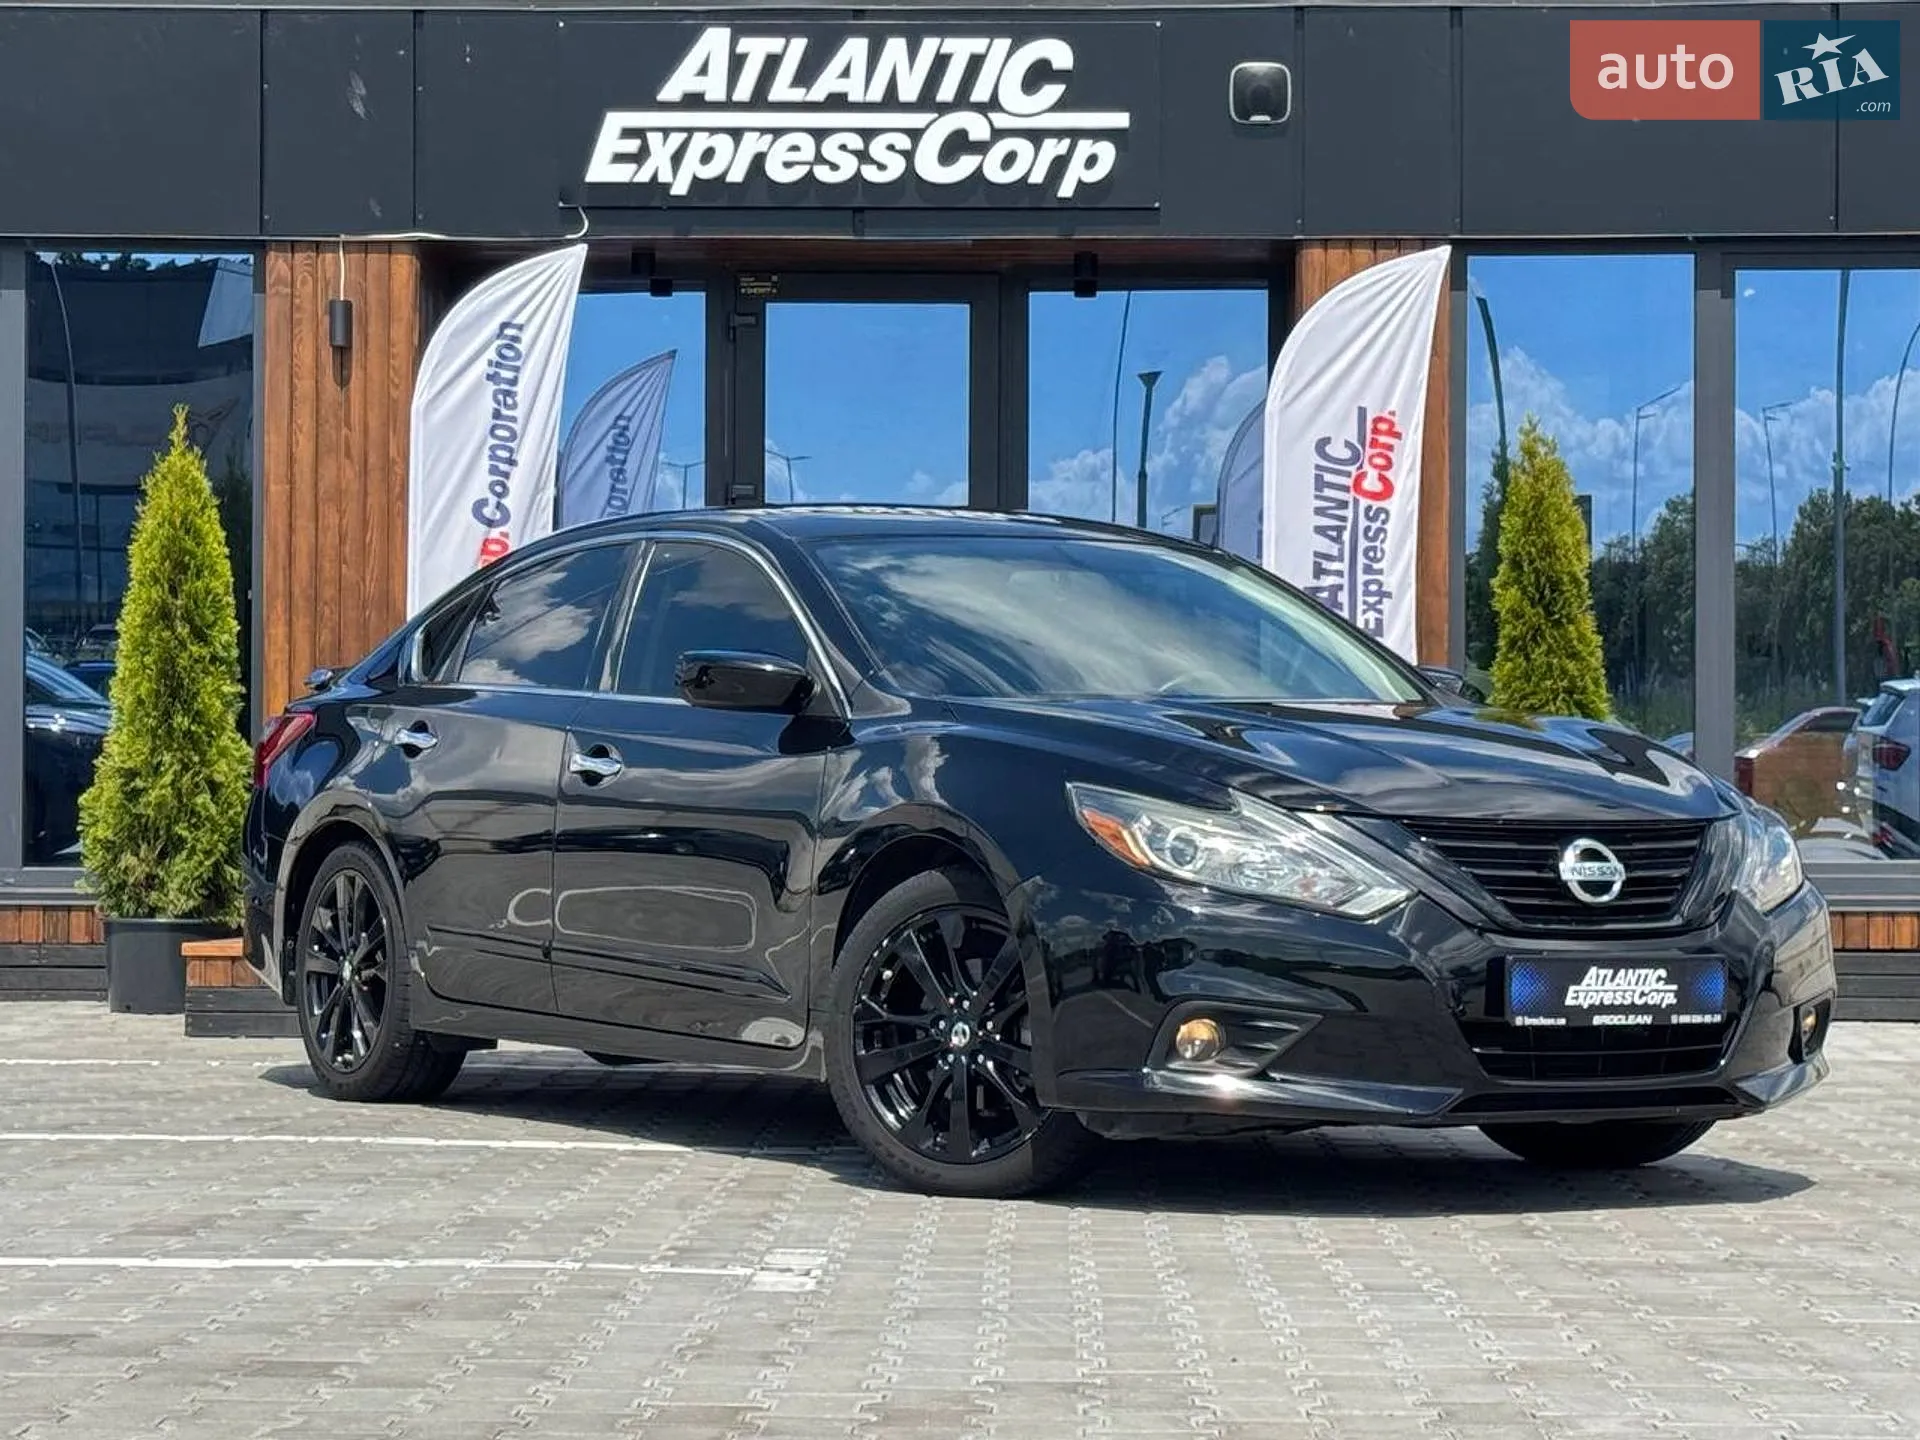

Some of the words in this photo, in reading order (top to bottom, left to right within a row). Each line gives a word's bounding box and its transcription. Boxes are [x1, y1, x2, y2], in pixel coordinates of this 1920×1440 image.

[657, 27, 1073, 115] ATLANTIC
[471, 321, 524, 528] Corporation
[1303, 436, 1361, 613] ATLANTIC
[1571, 866, 1624, 878] NISSAN
[1581, 966, 1667, 987] ATLANTIC
